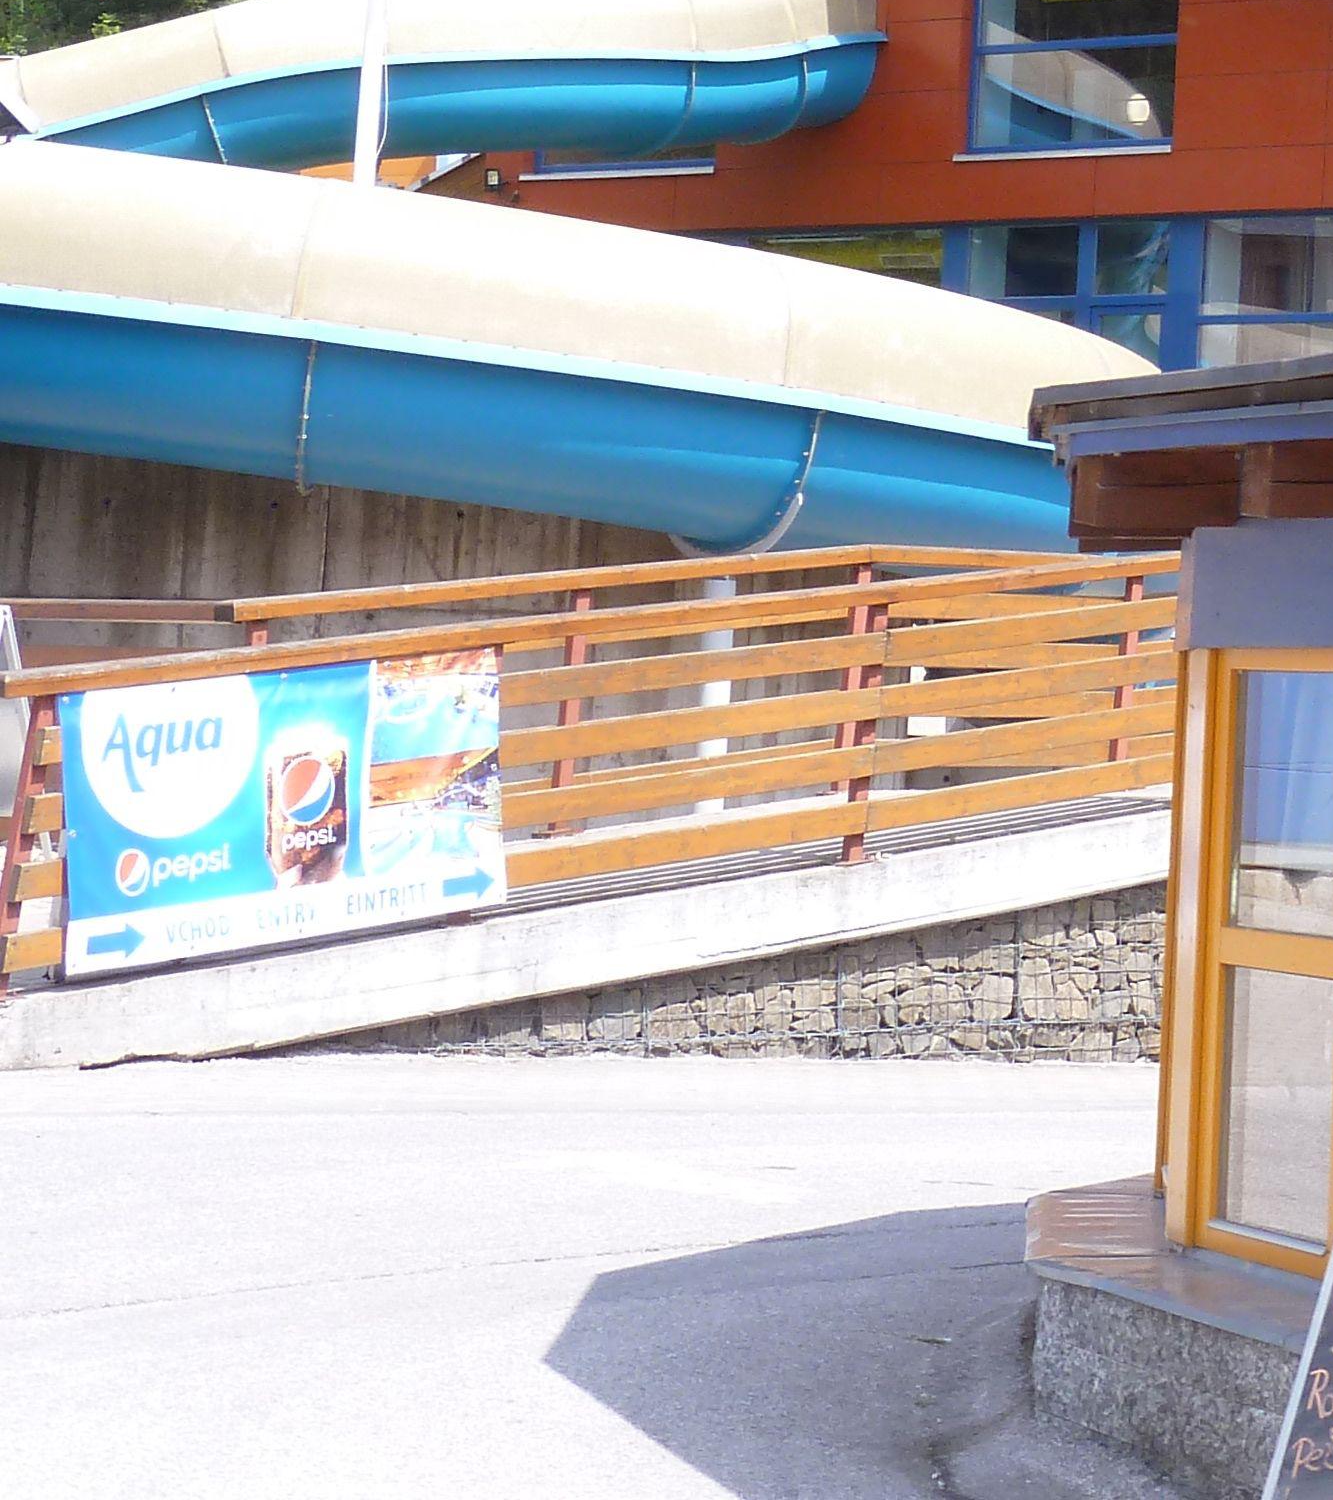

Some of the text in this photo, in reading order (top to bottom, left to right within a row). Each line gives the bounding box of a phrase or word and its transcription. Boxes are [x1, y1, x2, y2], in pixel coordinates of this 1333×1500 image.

[102, 713, 223, 793] Aqua
[281, 823, 334, 854] pepsi
[151, 845, 230, 888] pepsi
[347, 882, 428, 916] EINTRITT
